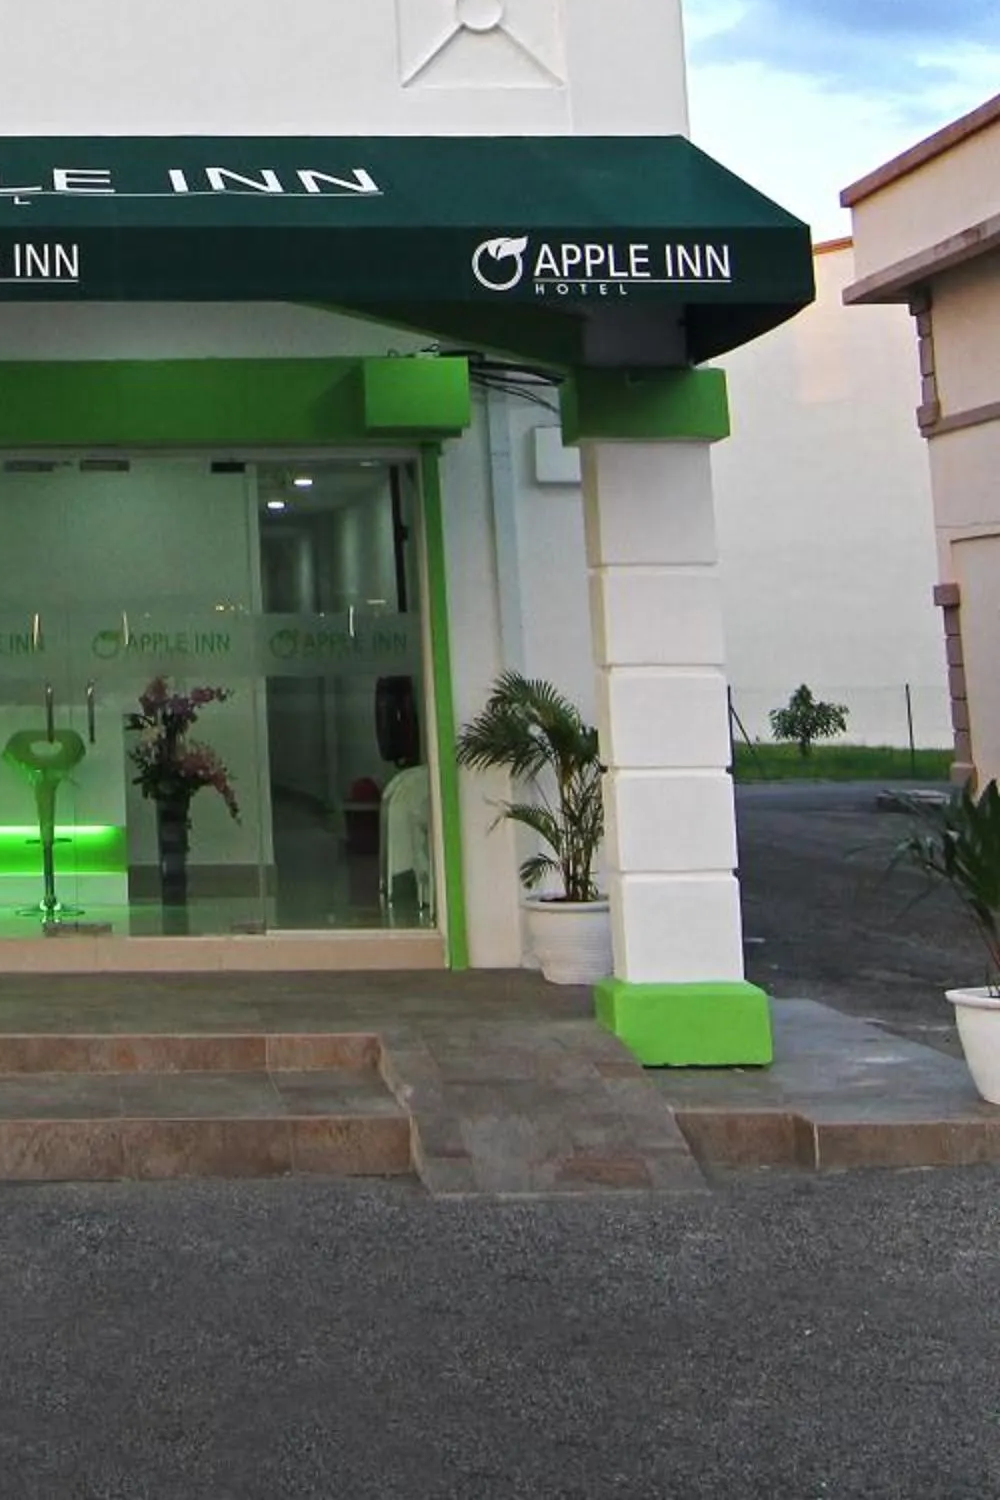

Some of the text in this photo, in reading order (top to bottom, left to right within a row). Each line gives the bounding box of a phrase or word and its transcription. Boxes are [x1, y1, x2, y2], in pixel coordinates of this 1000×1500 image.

[168, 167, 380, 194] INN
[14, 243, 80, 278] INN
[534, 244, 731, 279] APPLE INN
[535, 282, 628, 296] HOTEL
[127, 631, 231, 654] APPLE INN
[372, 631, 408, 653] INN
